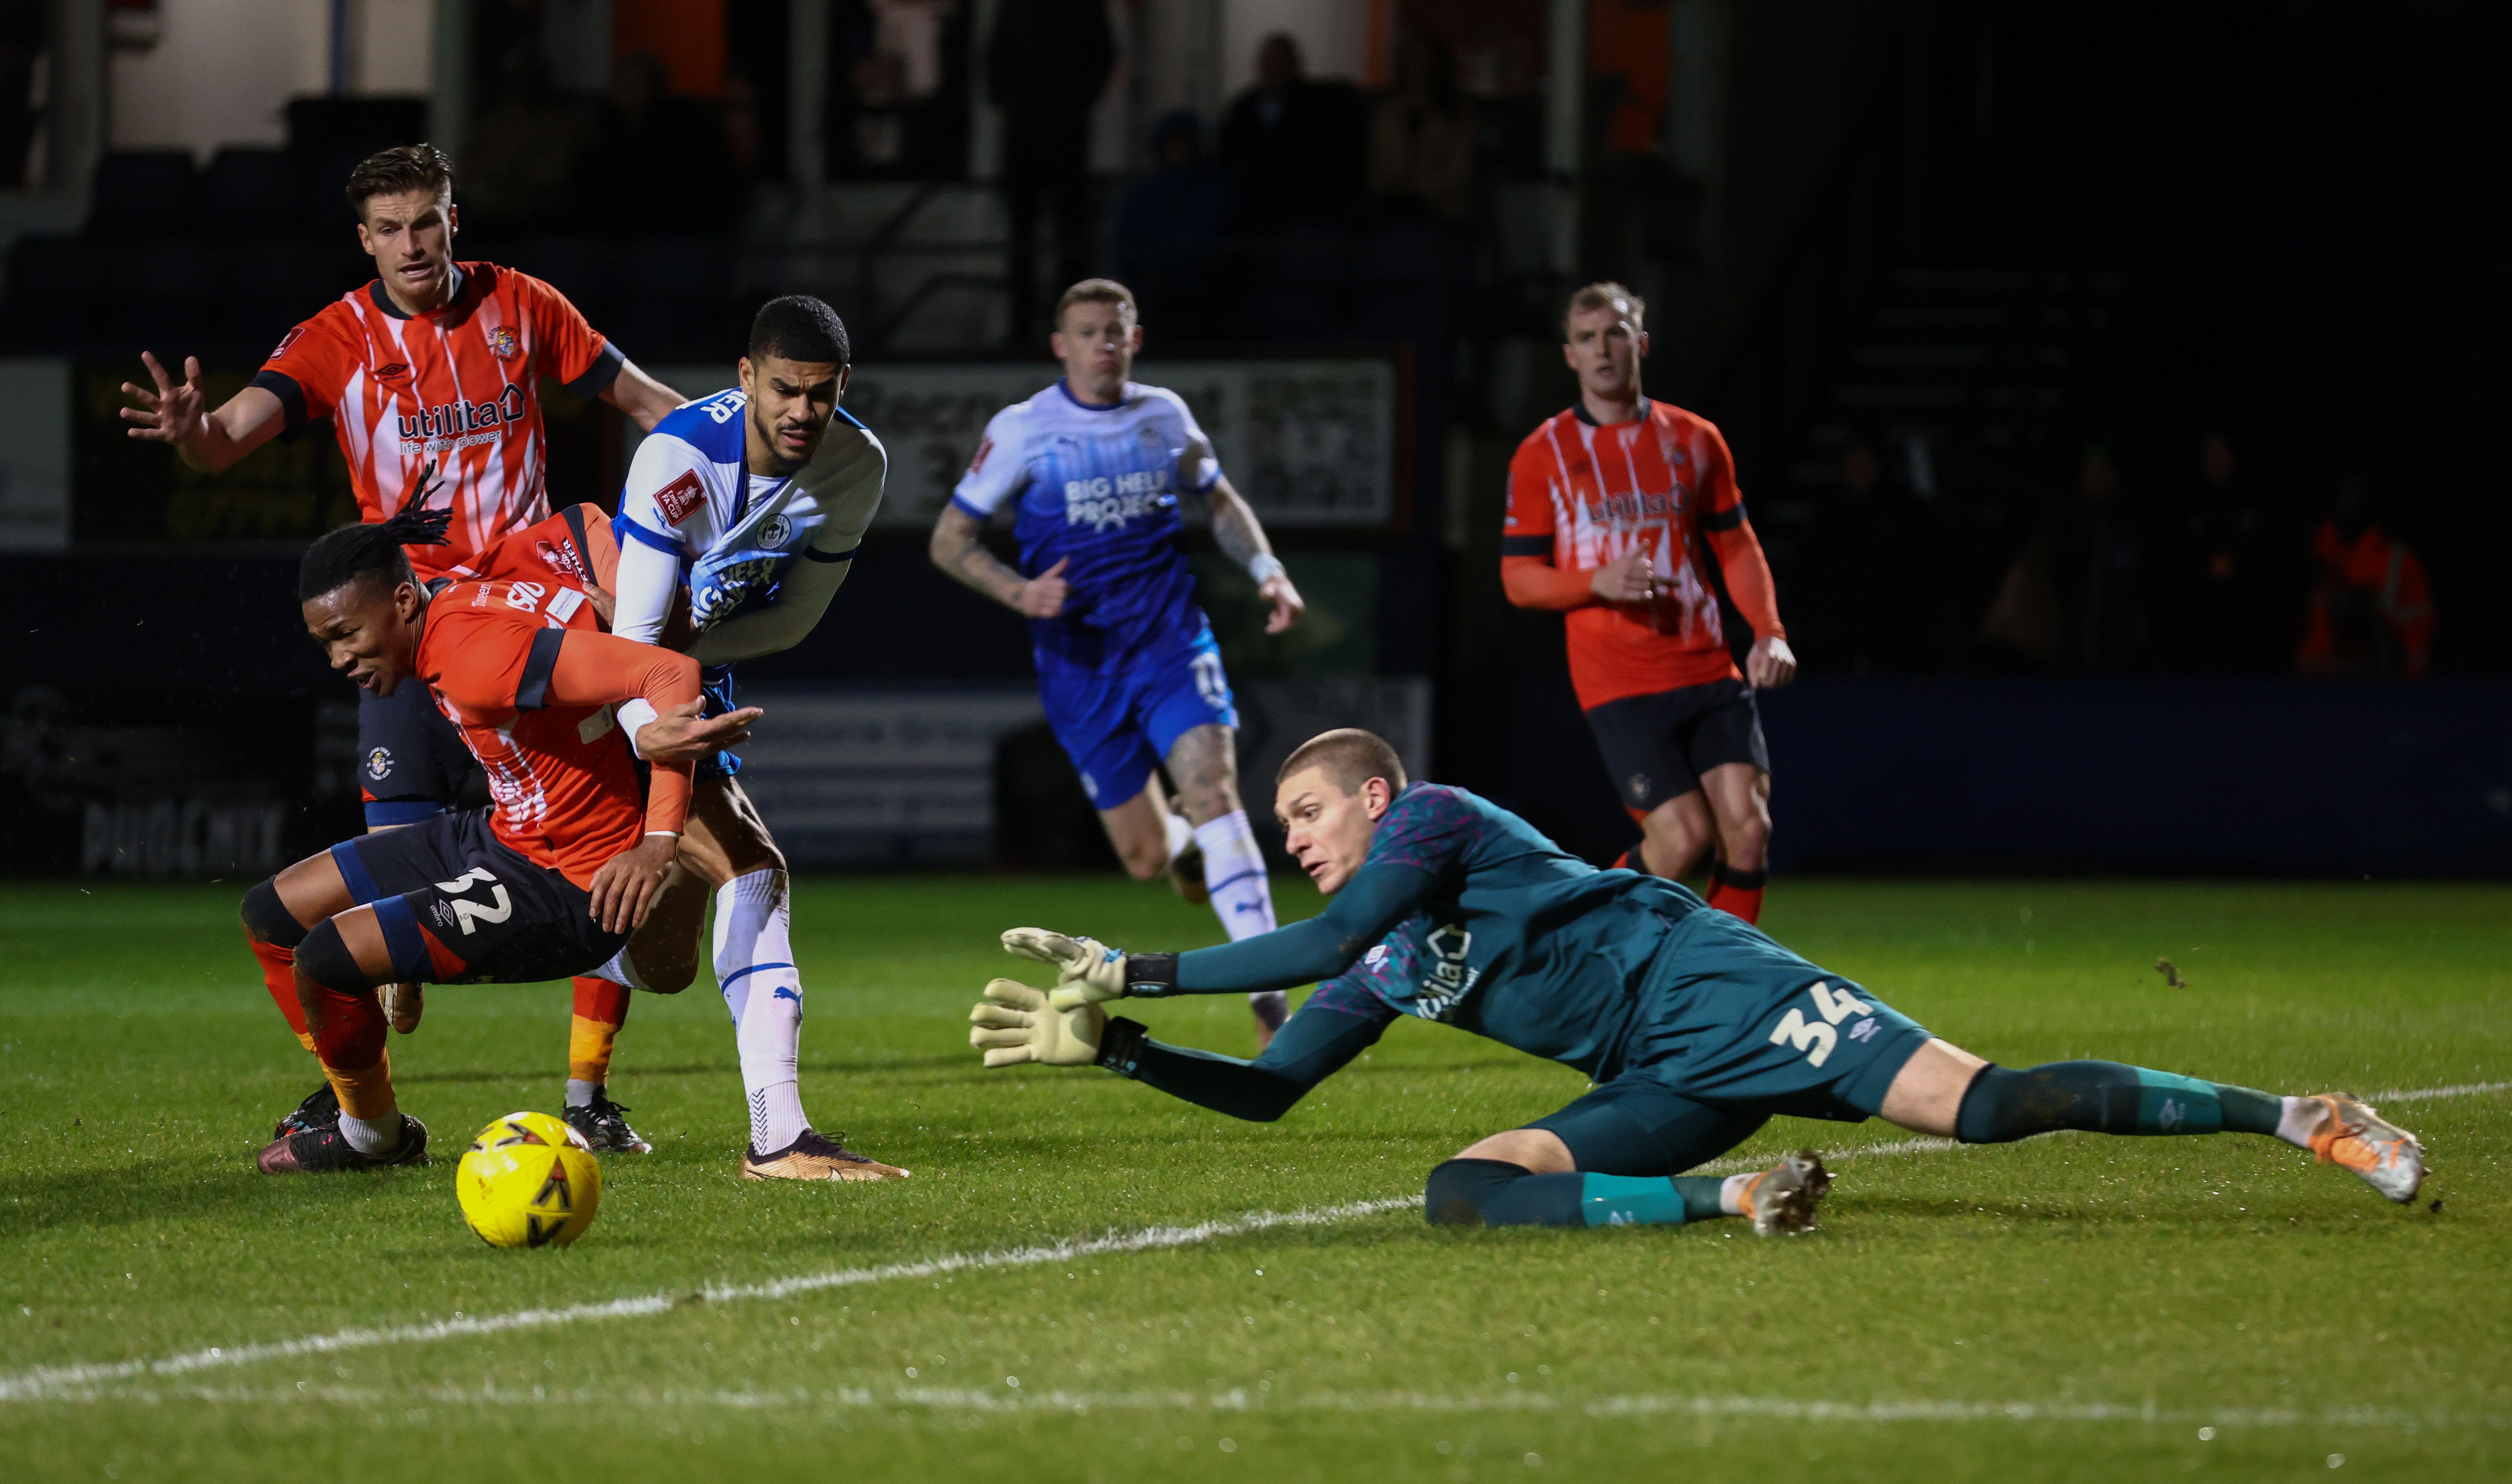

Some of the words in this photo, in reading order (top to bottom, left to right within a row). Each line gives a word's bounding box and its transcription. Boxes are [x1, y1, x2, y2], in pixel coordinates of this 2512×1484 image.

[398, 398, 501, 439] utilita
[400, 438, 422, 455] life
[425, 437, 455, 453] with
[458, 429, 503, 451] power
[1064, 476, 1111, 502] BIG
[661, 493, 671, 506] FA
[667, 503, 679, 519] CUP
[667, 489, 683, 516] Emirates
[1068, 492, 1163, 527] PROJEC
[430, 904, 444, 927] umbro
[1768, 980, 1875, 1068] 34
